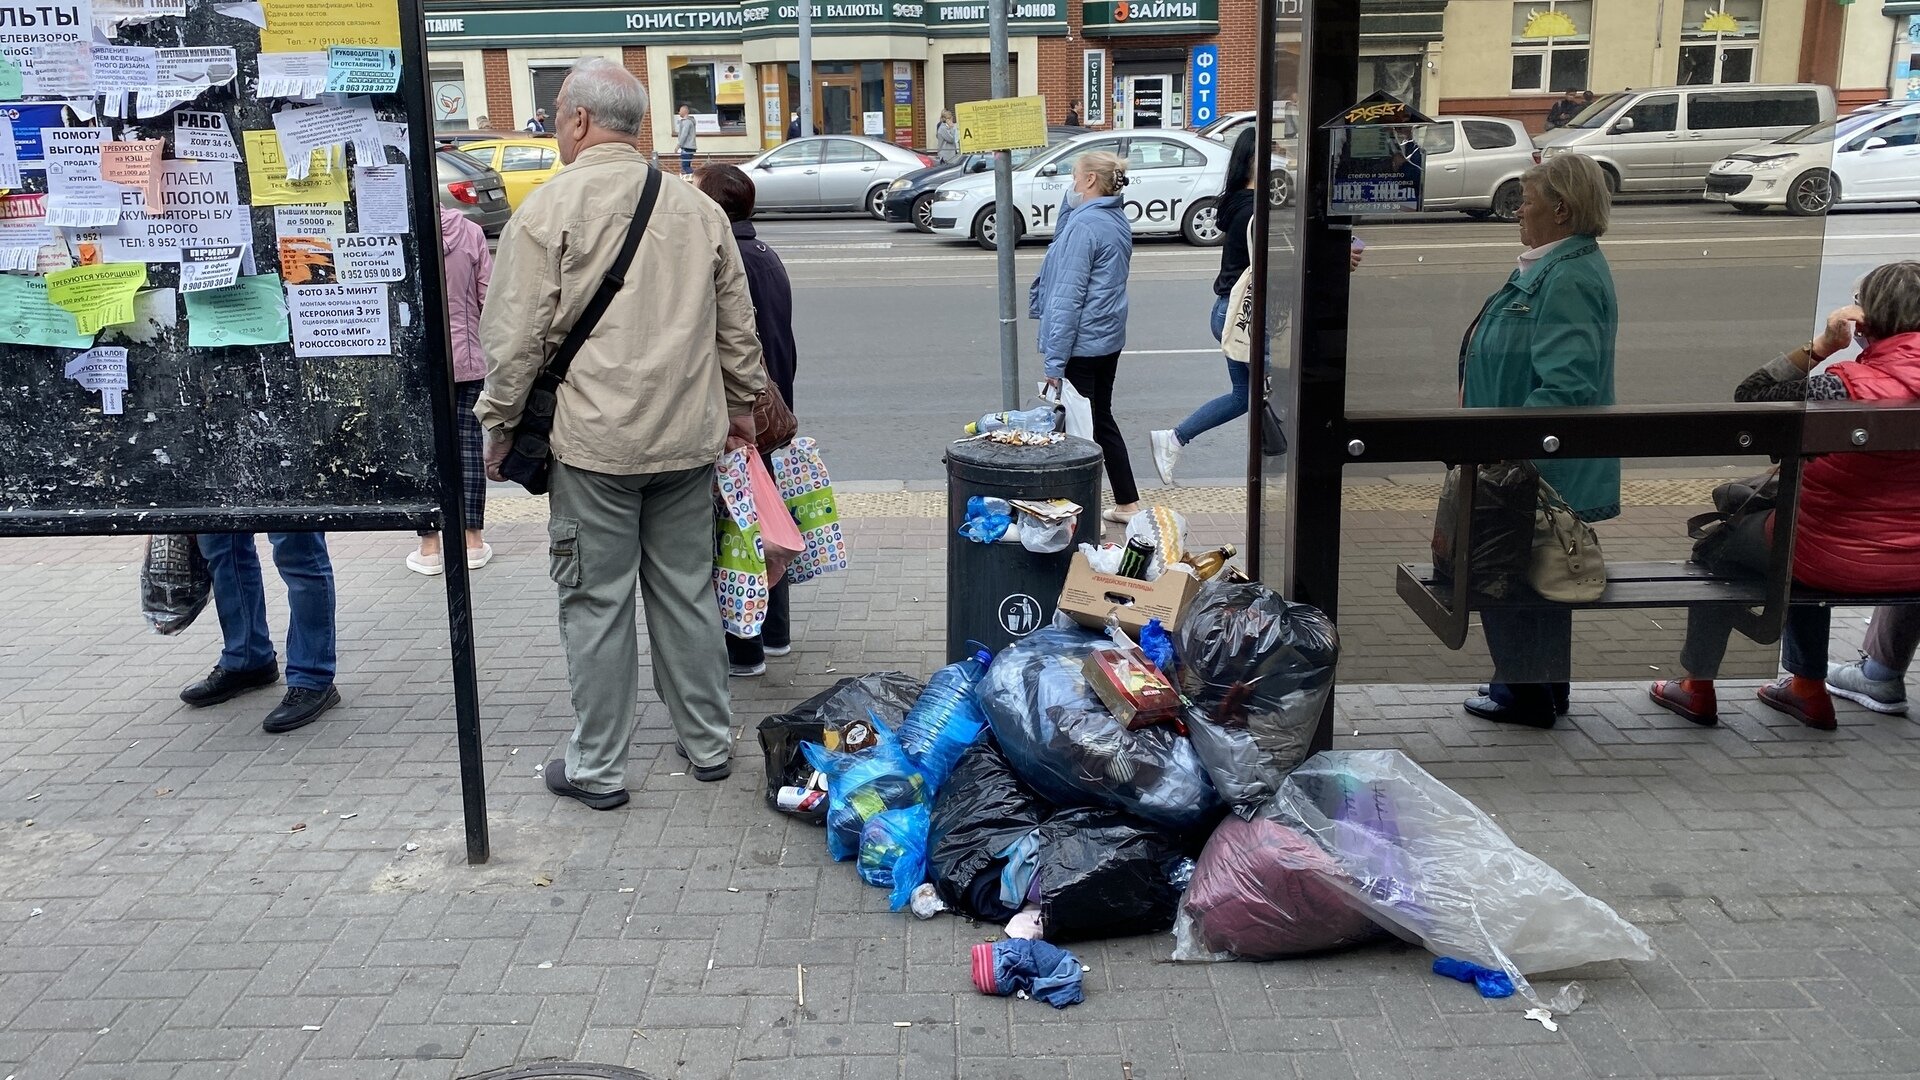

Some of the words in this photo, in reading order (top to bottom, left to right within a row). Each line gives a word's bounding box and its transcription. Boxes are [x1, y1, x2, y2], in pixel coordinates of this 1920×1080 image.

[827, 4, 883, 16] ВАЛЮТЫ
[940, 6, 985, 20] РЕМОНТ
[1129, 0, 1197, 18] ЗАЙМЫ
[626, 12, 742, 28] ЮНИСТРИМ
[1197, 52, 1213, 120] ФОТО
[53, 131, 100, 139] ПОМОГУ
[183, 150, 238, 159] 8-911-851-01-49
[214, 210, 232, 219] Б/У
[148, 224, 198, 235] ДОРОГО
[119, 239, 145, 247] ТЕЛ:
[149, 238, 154, 247] 8
[158, 238, 176, 247] 952
[180, 238, 197, 246] 117
[337, 236, 397, 247] РАБОТА
[190, 248, 235, 257] ПРИМУ
[52, 274, 94, 287] ТРЕБУЮТСЯ
[95, 270, 140, 279] УБОРЩИЦЫ!
[341, 271, 346, 279] 8
[364, 268, 378, 277] 059
[381, 268, 390, 277] 00
[392, 268, 401, 276] 88
[189, 282, 201, 290] 900
[202, 280, 214, 288] 570
[338, 286, 344, 295] 5
[300, 309, 354, 318] КСЕРОКОПИЯ
[356, 306, 363, 316] 3
[300, 340, 374, 348] РОКОССОВСКОГО
